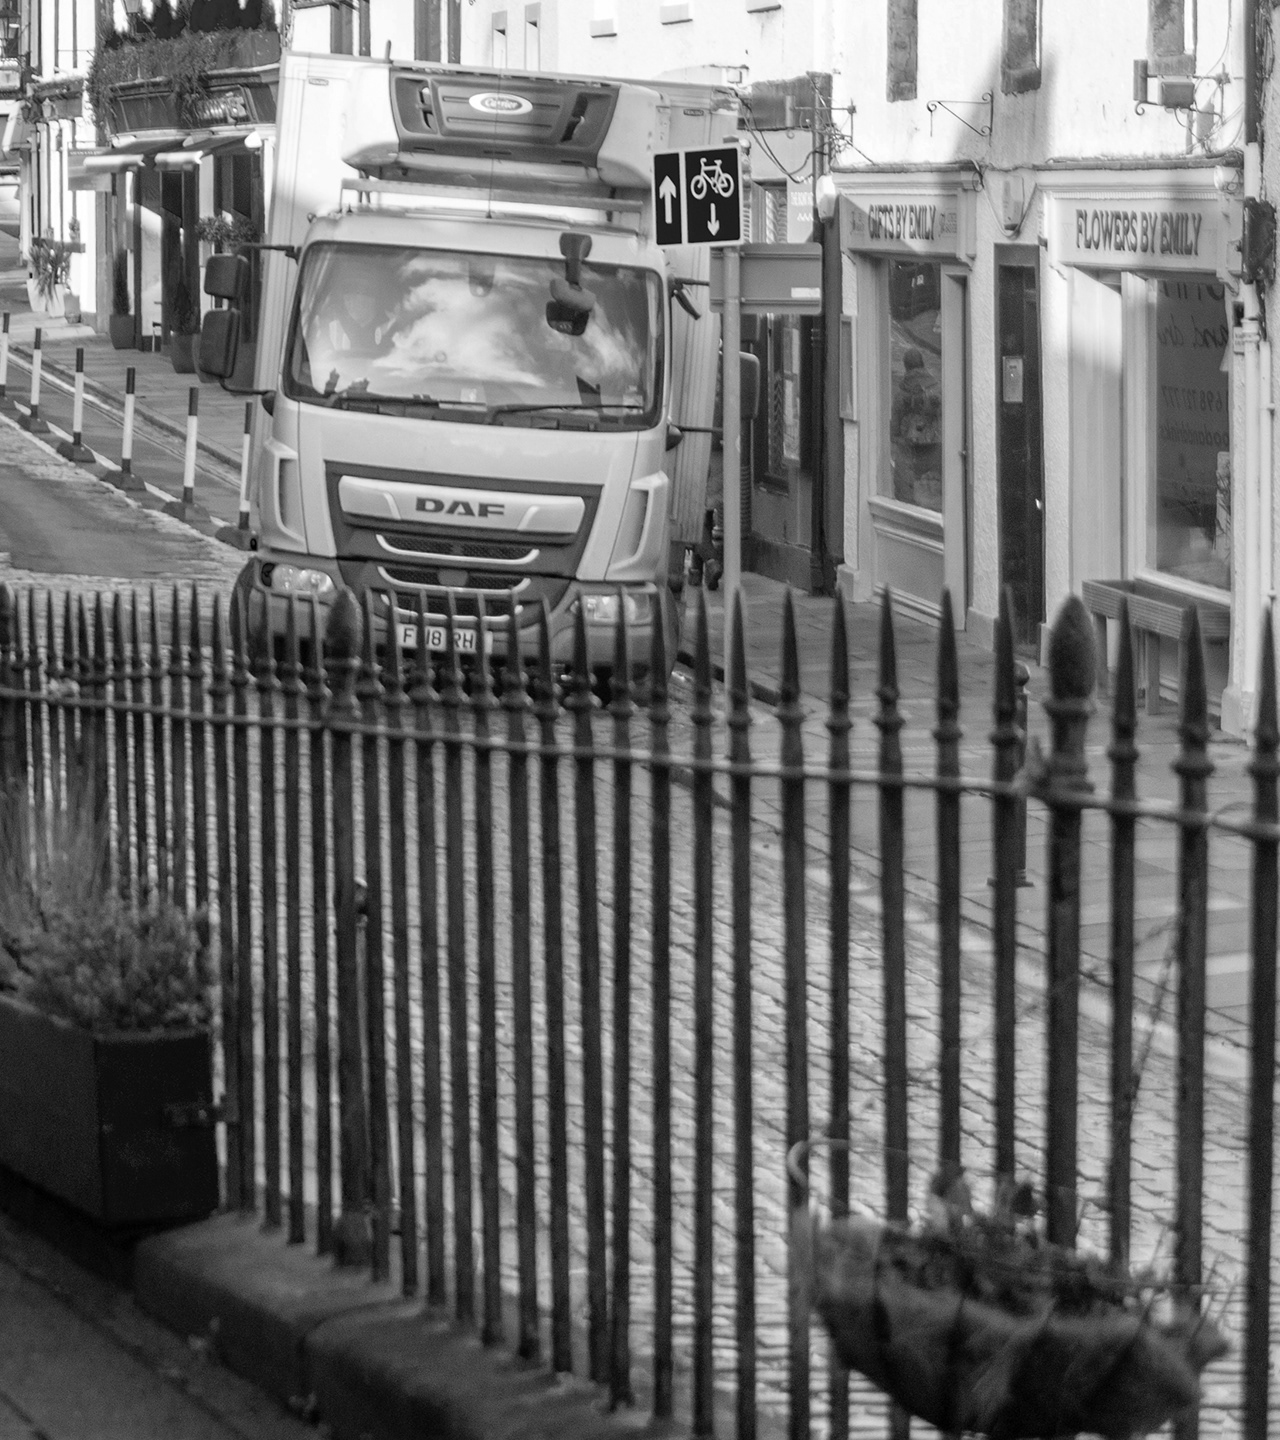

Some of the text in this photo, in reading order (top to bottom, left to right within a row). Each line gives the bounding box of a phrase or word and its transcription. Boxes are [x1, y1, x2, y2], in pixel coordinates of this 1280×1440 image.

[868, 203, 895, 240] GIFTS
[895, 204, 908, 240] BY
[908, 204, 937, 241] EMILY
[1075, 209, 1203, 256] FLOWERS BY EMILY
[415, 497, 505, 518] DAF
